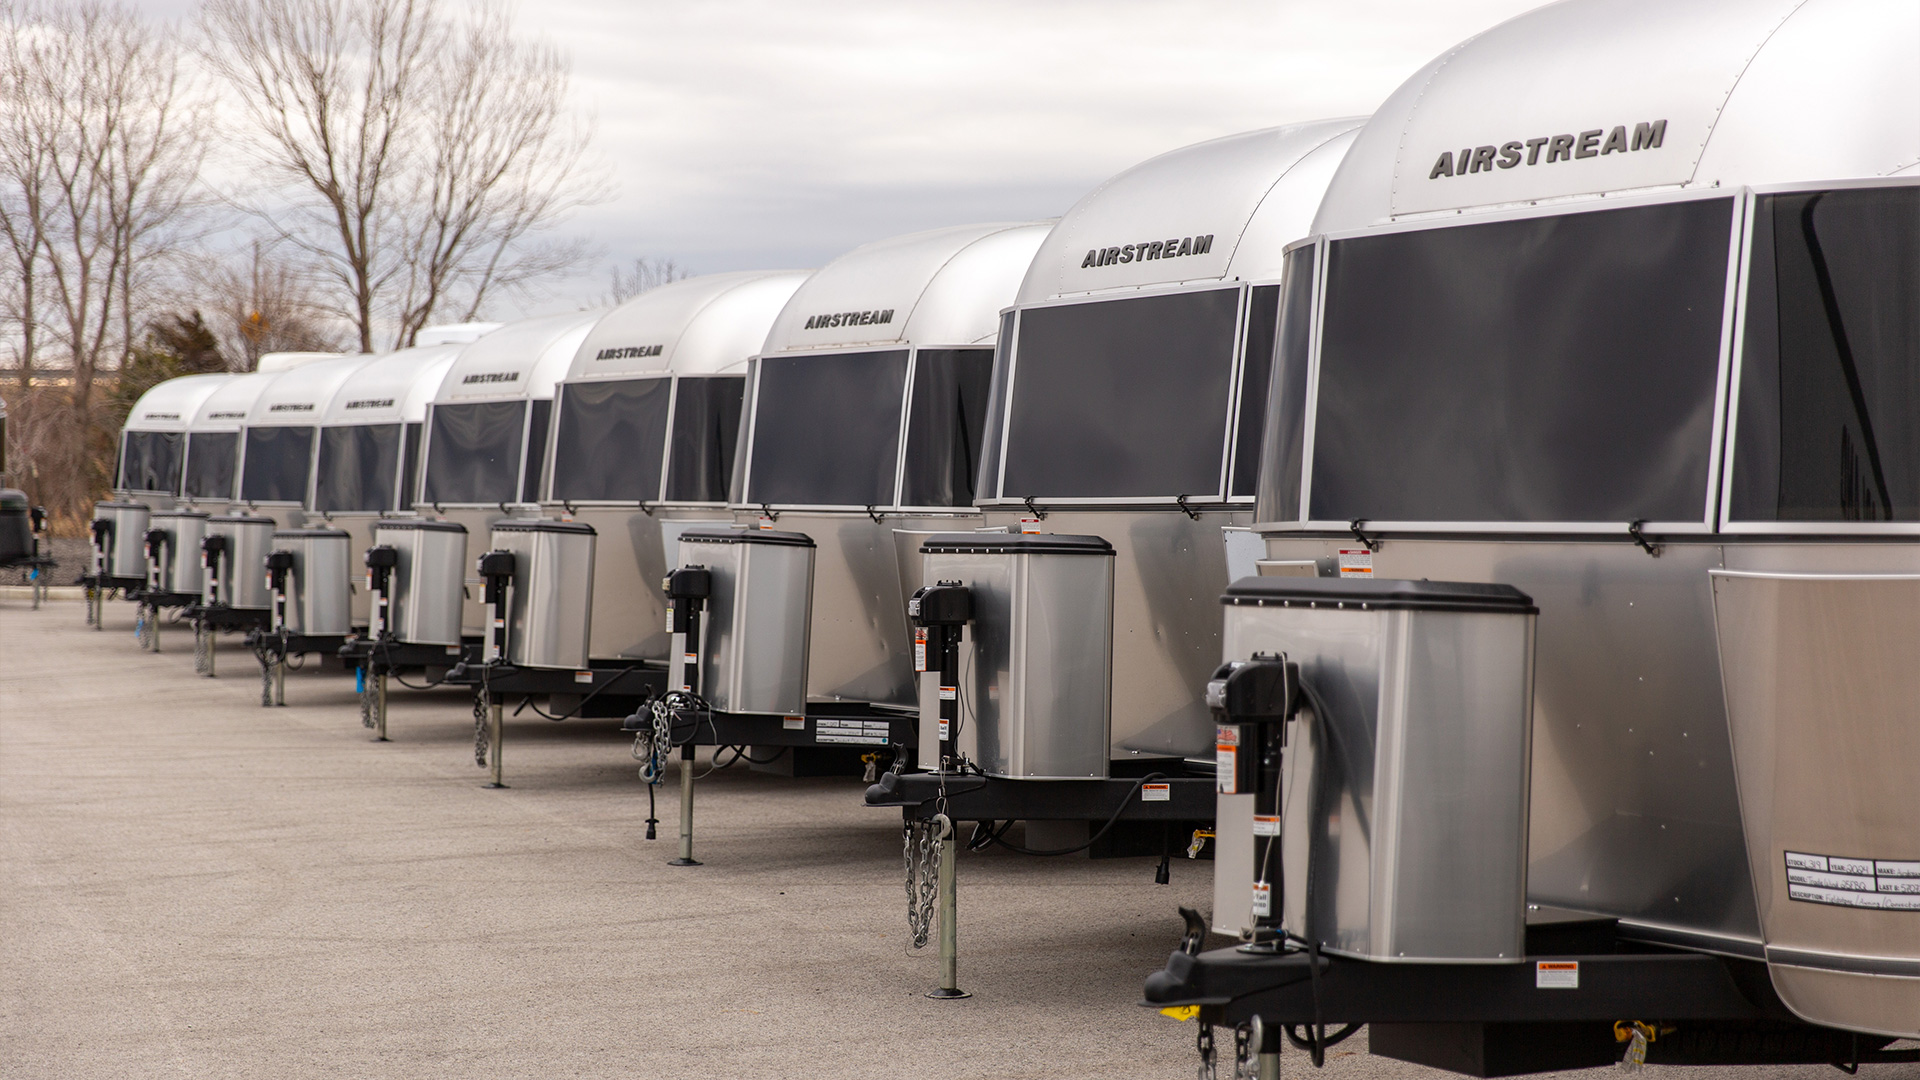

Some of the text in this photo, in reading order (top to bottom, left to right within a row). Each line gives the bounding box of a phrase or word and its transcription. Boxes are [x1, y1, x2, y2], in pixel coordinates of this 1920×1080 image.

[1428, 119, 1668, 180] AIRSTREAM
[1080, 234, 1214, 269] AIRSTREAM
[804, 309, 895, 330] AIRSTREAM
[596, 344, 664, 361] AIRSTREAM
[462, 372, 520, 384] AIRSTREAM
